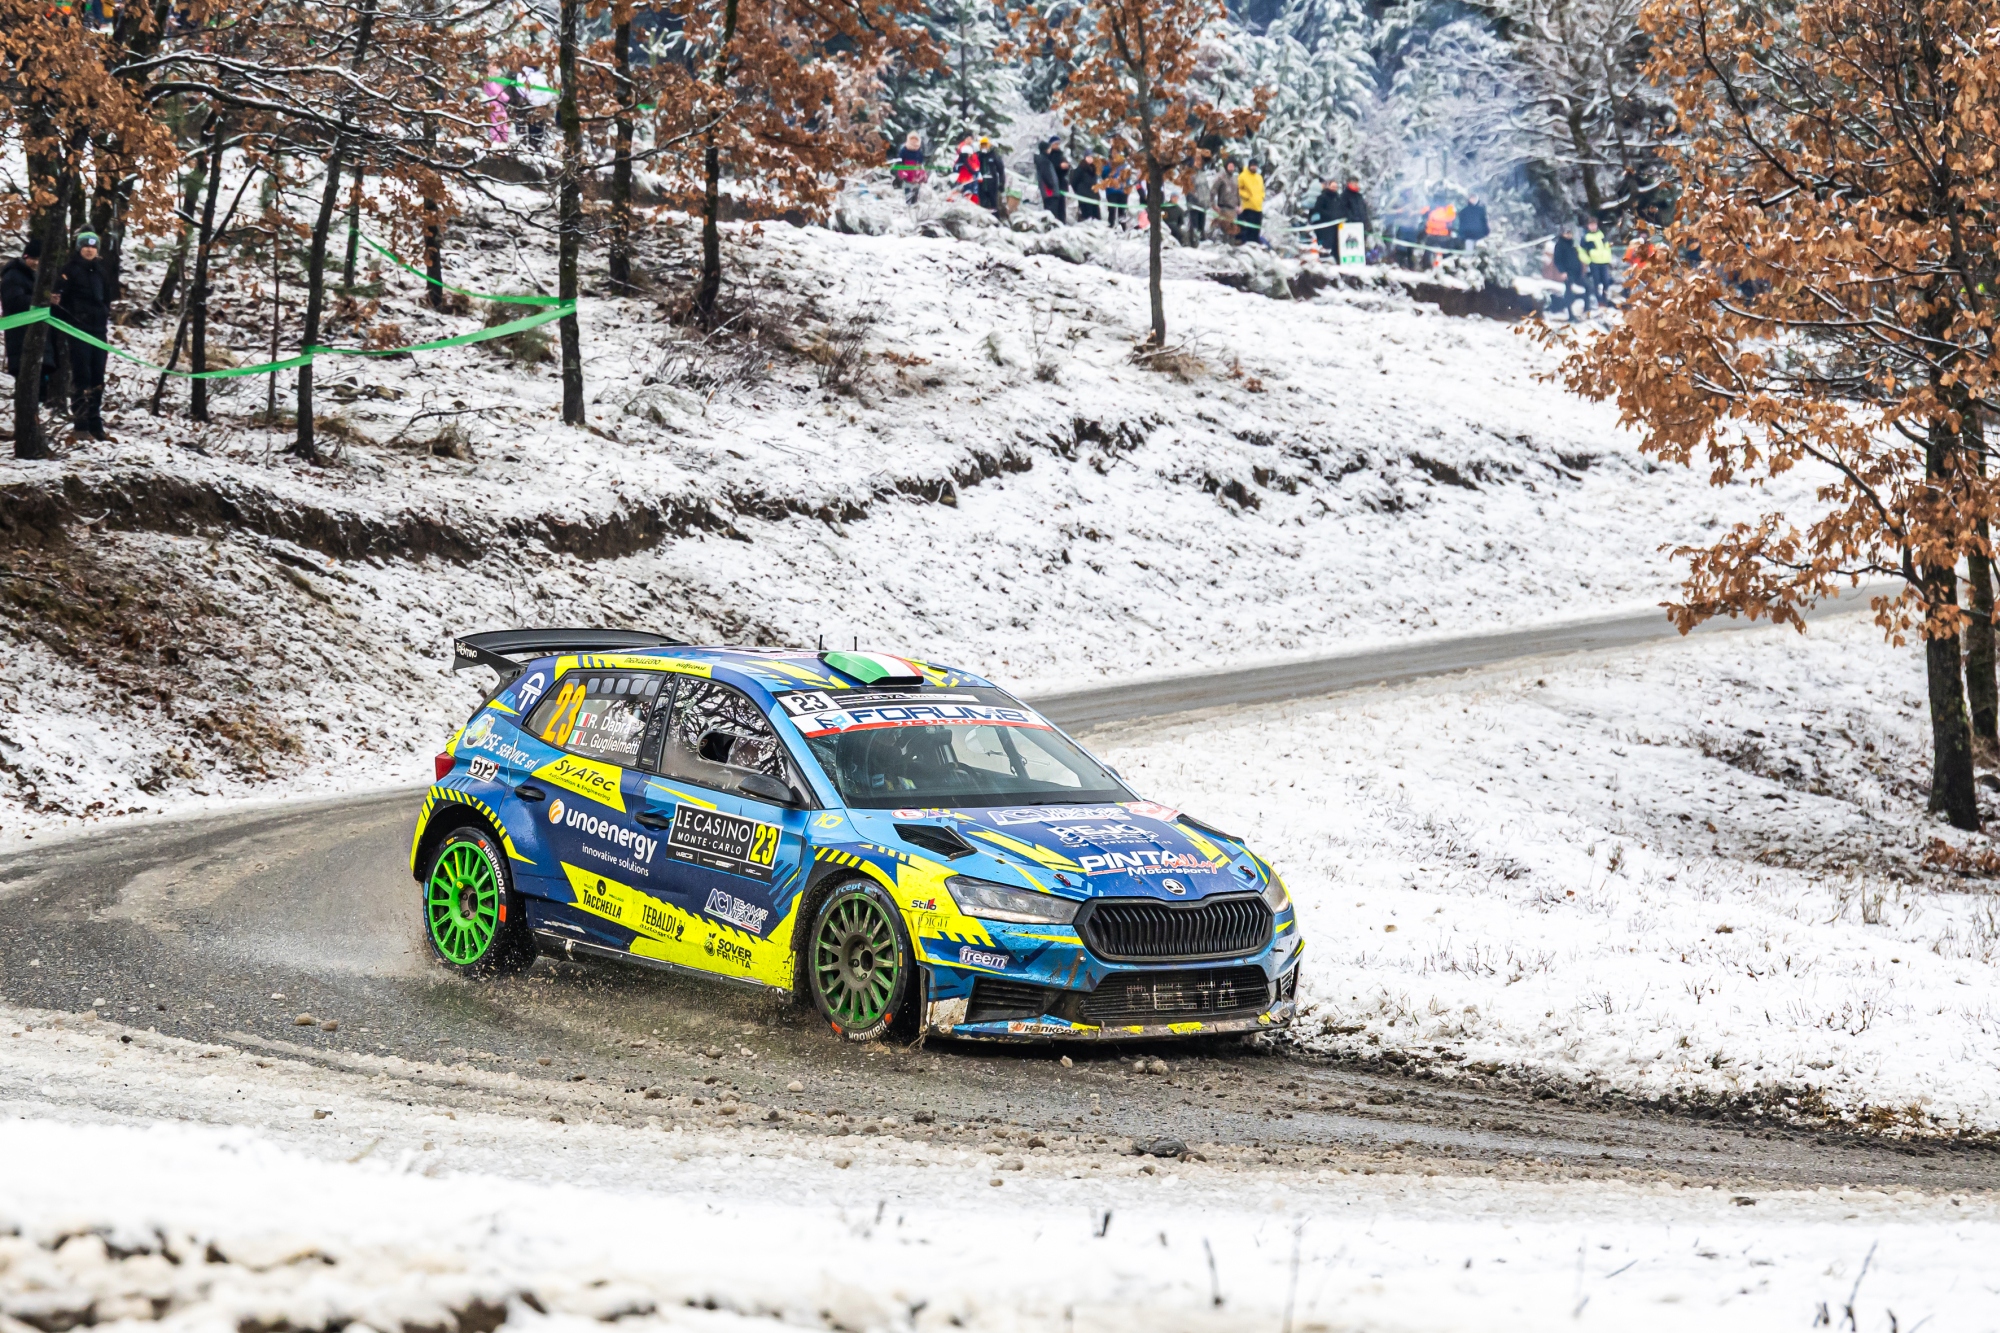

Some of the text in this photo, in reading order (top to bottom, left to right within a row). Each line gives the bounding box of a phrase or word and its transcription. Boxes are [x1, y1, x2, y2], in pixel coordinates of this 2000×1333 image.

[790, 694, 829, 711] 23
[846, 705, 1029, 723] FORUM8
[540, 682, 587, 747] 23
[587, 714, 598, 729] R.
[496, 742, 530, 766] SERVICE
[581, 732, 641, 755] L. Guglielmetti
[554, 759, 616, 791] SyATec
[581, 784, 611, 801] Engineering
[565, 808, 658, 864] unoenergy
[676, 809, 751, 843] LE CASINO
[749, 823, 778, 866] 23
[582, 842, 649, 877] innovative solutions
[1078, 850, 1180, 872] PINTA
[1126, 865, 1211, 877] Motorsport
[582, 888, 622, 919] TACCHELLA
[705, 888, 733, 917] ACI
[733, 897, 762, 916] TEAM
[911, 898, 937, 911] Stilo
[641, 904, 677, 935] TEBALDI
[731, 908, 763, 930] ITALIA
[716, 948, 751, 970] FRUTTA
[717, 938, 752, 962] SOVER
[961, 948, 1006, 968] freem
